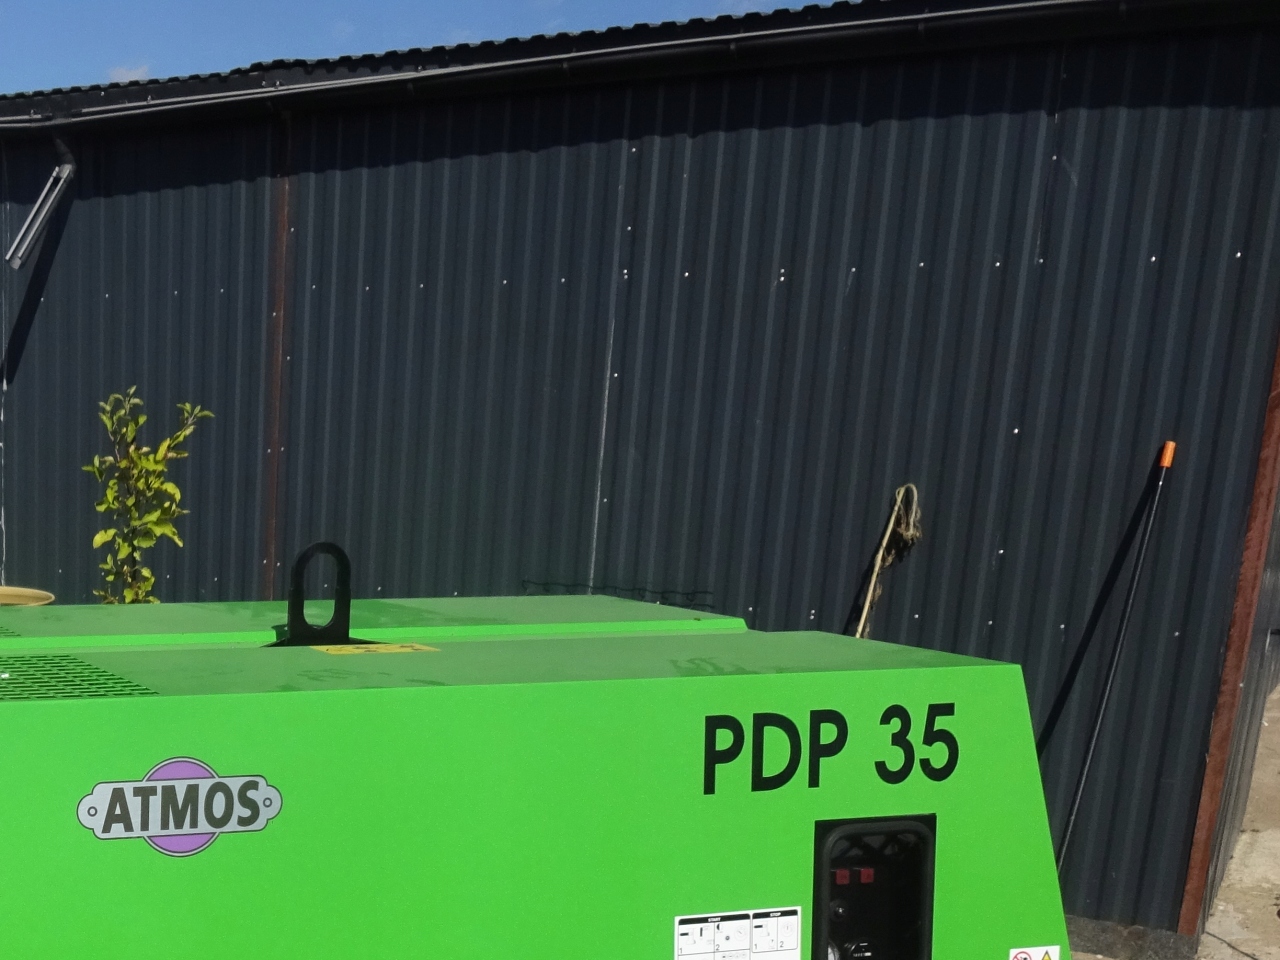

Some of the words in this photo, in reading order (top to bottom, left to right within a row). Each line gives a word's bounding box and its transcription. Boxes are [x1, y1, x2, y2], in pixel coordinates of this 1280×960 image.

[703, 709, 849, 795] PDP
[874, 702, 960, 785] 35
[101, 779, 261, 834] ATMOS
